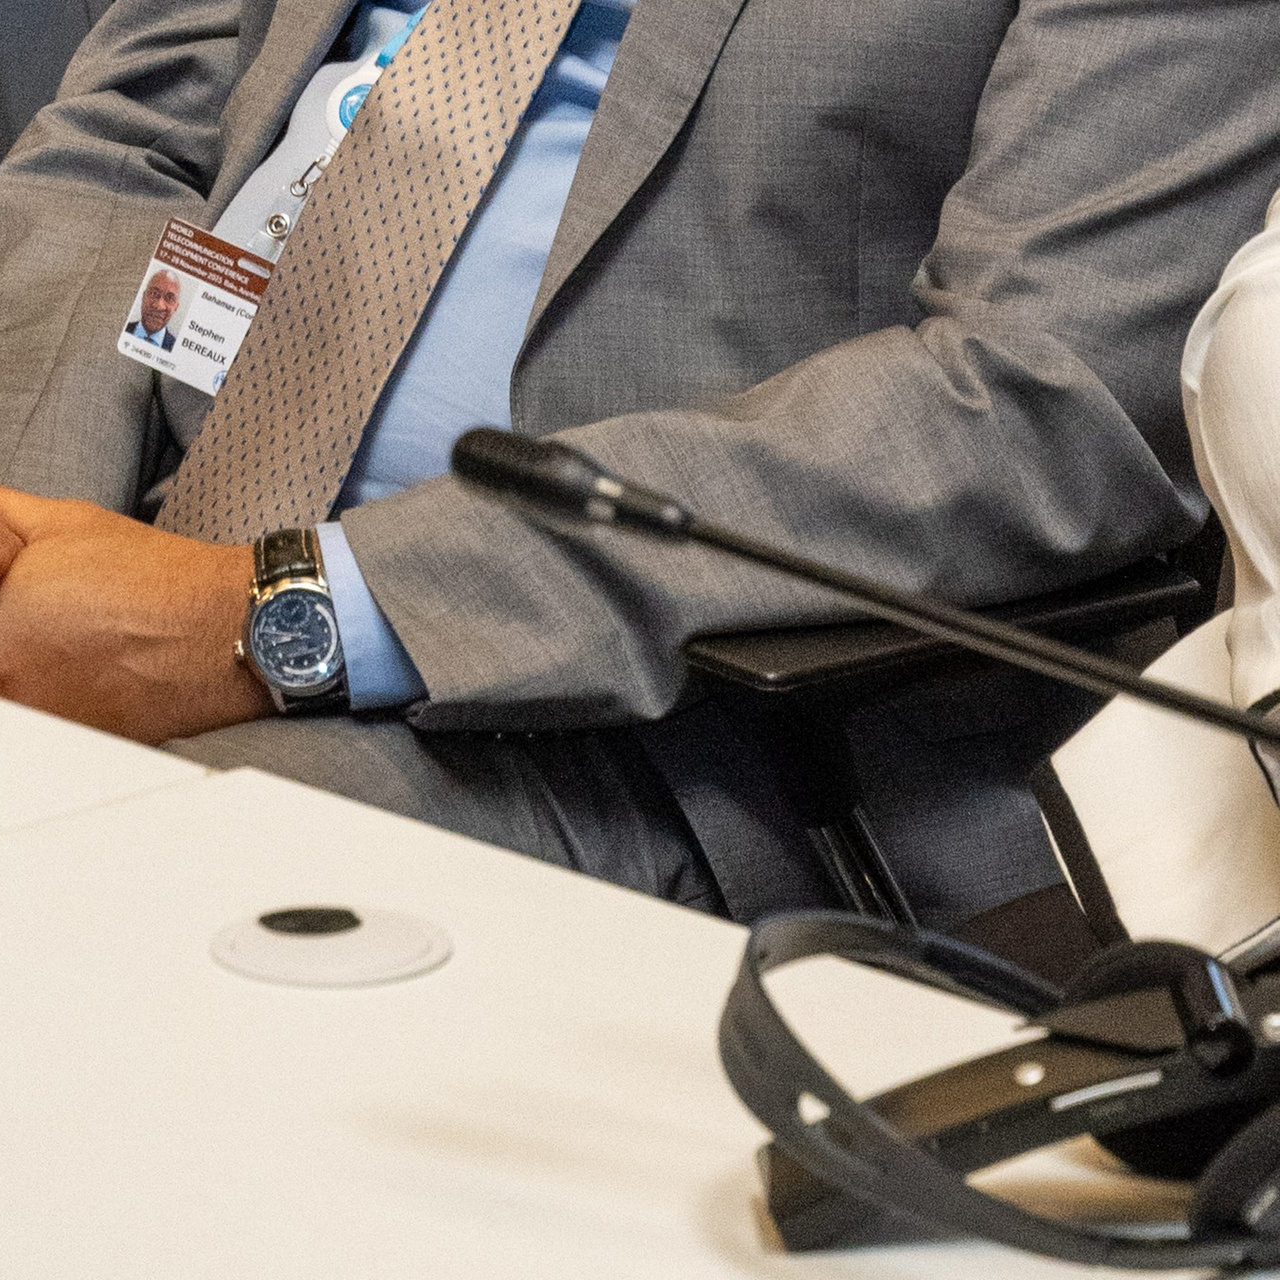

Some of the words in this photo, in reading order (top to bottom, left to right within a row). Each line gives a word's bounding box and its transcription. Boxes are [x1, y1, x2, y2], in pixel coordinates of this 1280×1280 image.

[169, 222, 195, 238] WORLD
[167, 231, 235, 267] TELECOMMUNICATION
[162, 240, 208, 266] DEVELOPMENT
[207, 260, 250, 285] CONFERENCE
[179, 259, 208, 277] November
[201, 291, 236, 312] Bahamas
[188, 321, 226, 345] Stephen
[180, 338, 227, 366] BEREAUX
